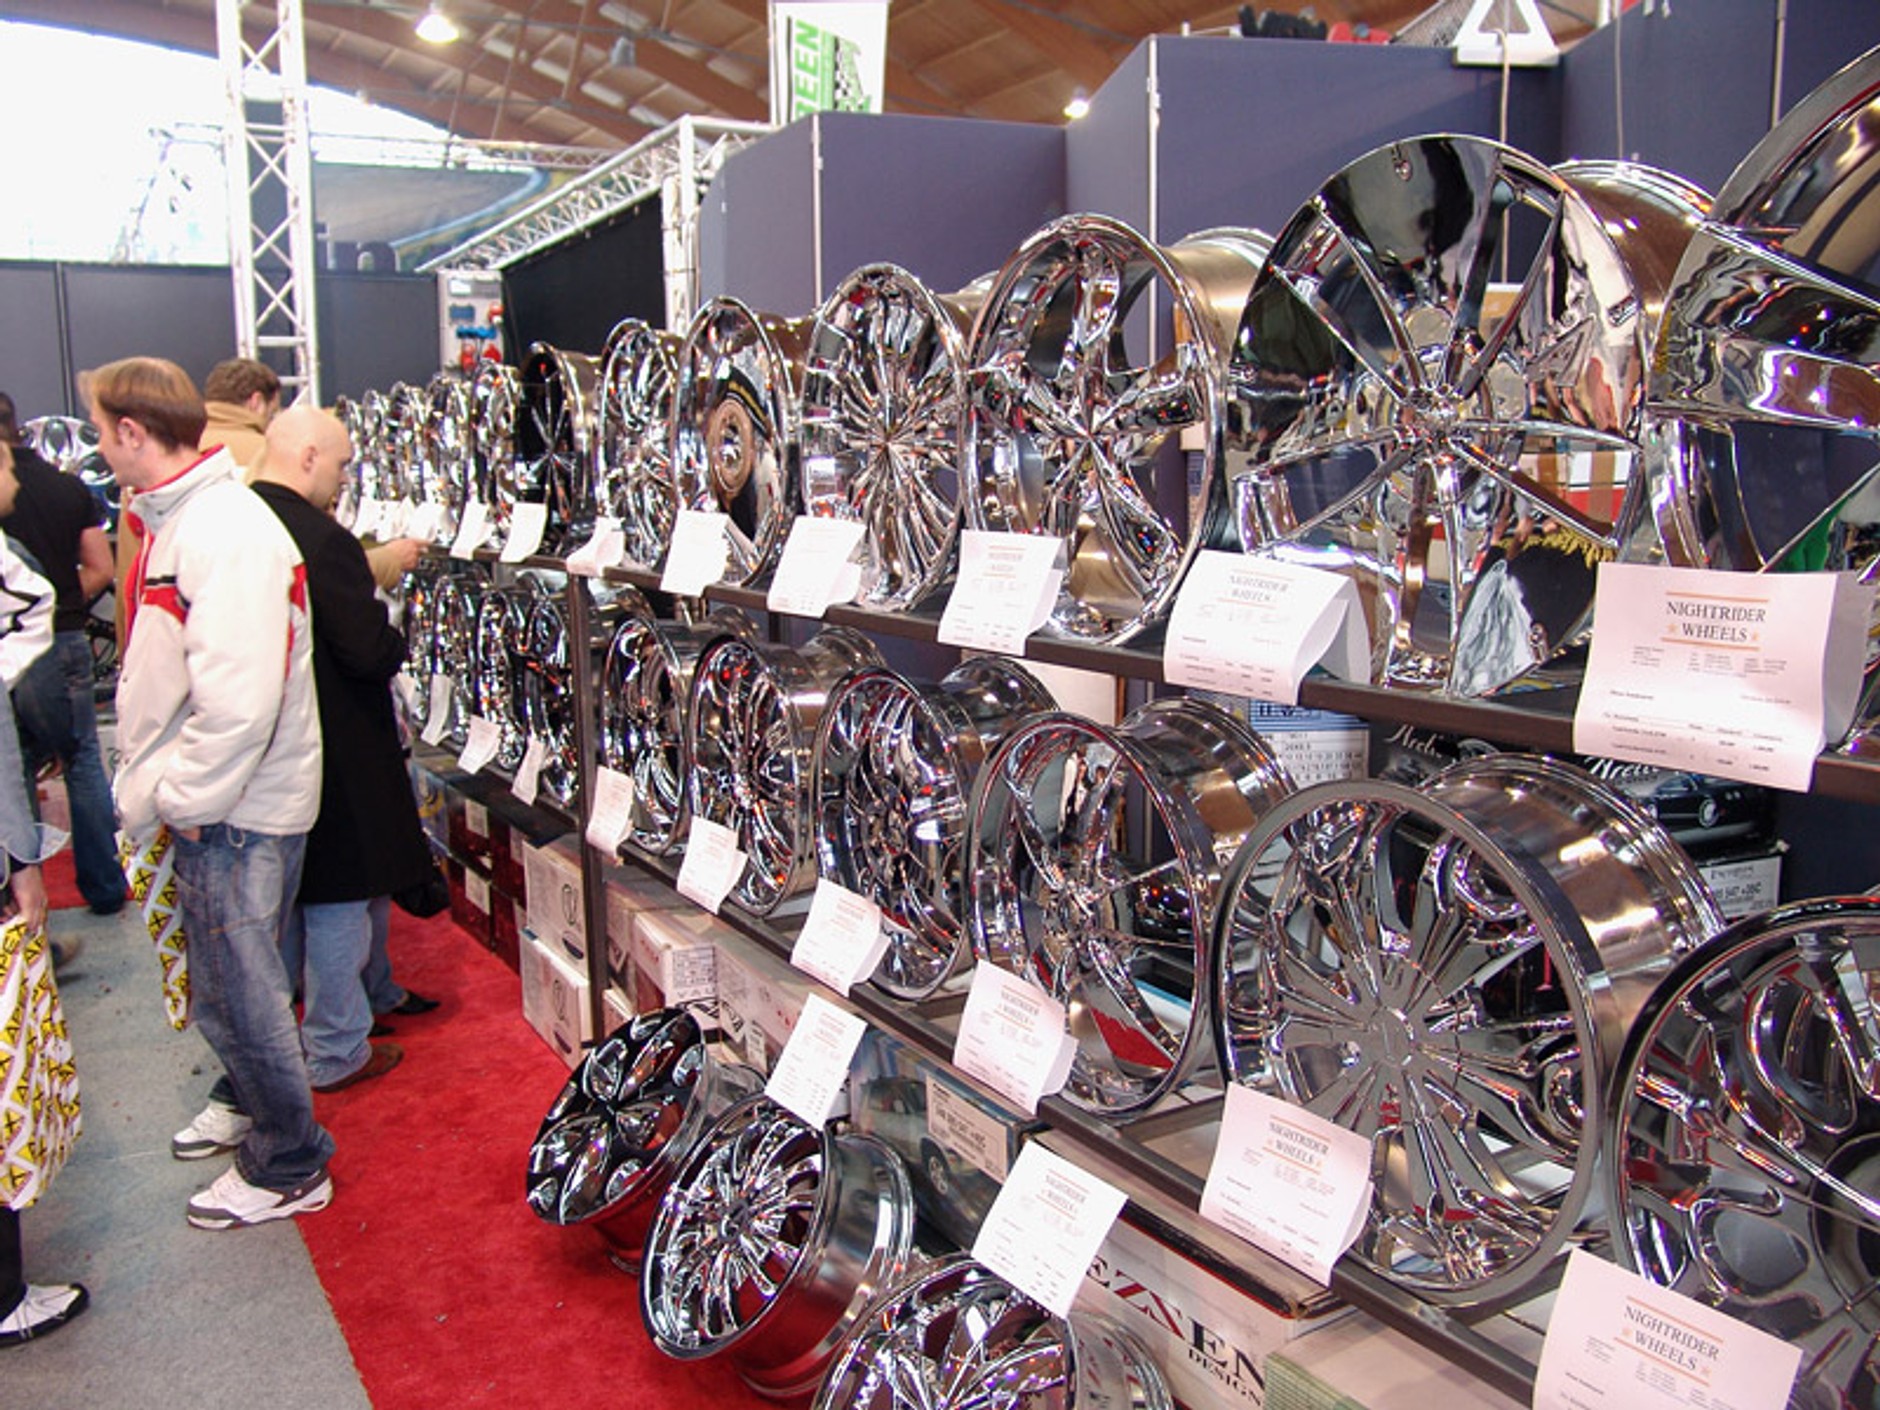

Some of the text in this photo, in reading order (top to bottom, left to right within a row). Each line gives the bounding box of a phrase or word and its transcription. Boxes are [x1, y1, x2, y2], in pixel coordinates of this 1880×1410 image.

[1667, 601, 1766, 622] NIGHTRIDER
[1682, 622, 1748, 642] WHEELS
[1624, 1304, 1719, 1361] NIGHTRIDER
[1635, 1329, 1698, 1371] WHEELS
[1188, 1348, 1262, 1407] DESIGN
